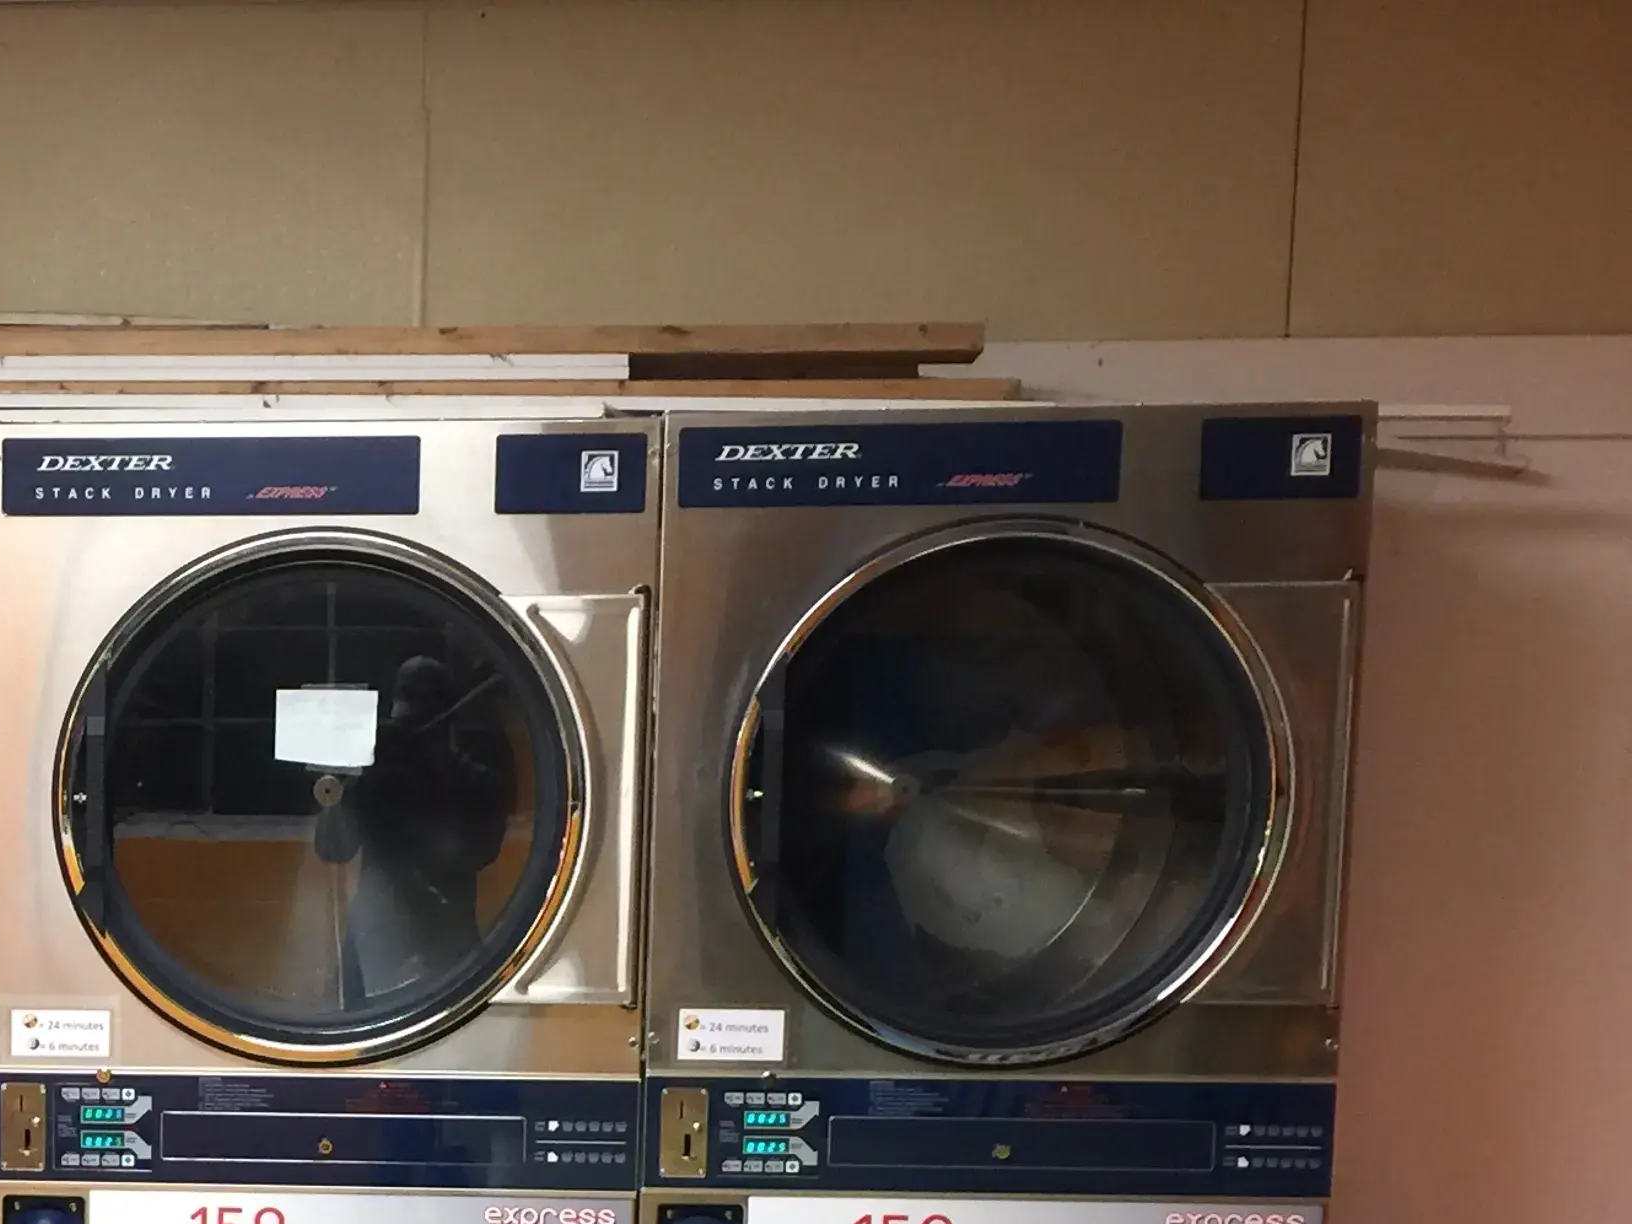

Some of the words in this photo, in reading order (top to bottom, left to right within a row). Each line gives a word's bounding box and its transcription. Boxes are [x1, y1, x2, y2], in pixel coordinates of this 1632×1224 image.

[716, 443, 859, 460] DEXTER
[38, 455, 173, 471] DEXTER
[715, 477, 793, 490] STACK
[820, 476, 898, 488] DRYER
[37, 488, 111, 499] STACK
[136, 487, 211, 498] DRYER
[48, 1020, 60, 1030] 24
[62, 1021, 104, 1031] minutes
[709, 1022, 723, 1032] 24
[725, 1023, 769, 1034] minutes
[48, 1042, 56, 1051] 6
[58, 1043, 100, 1052] minutes
[709, 1044, 717, 1053] 6
[719, 1045, 764, 1055] minutes
